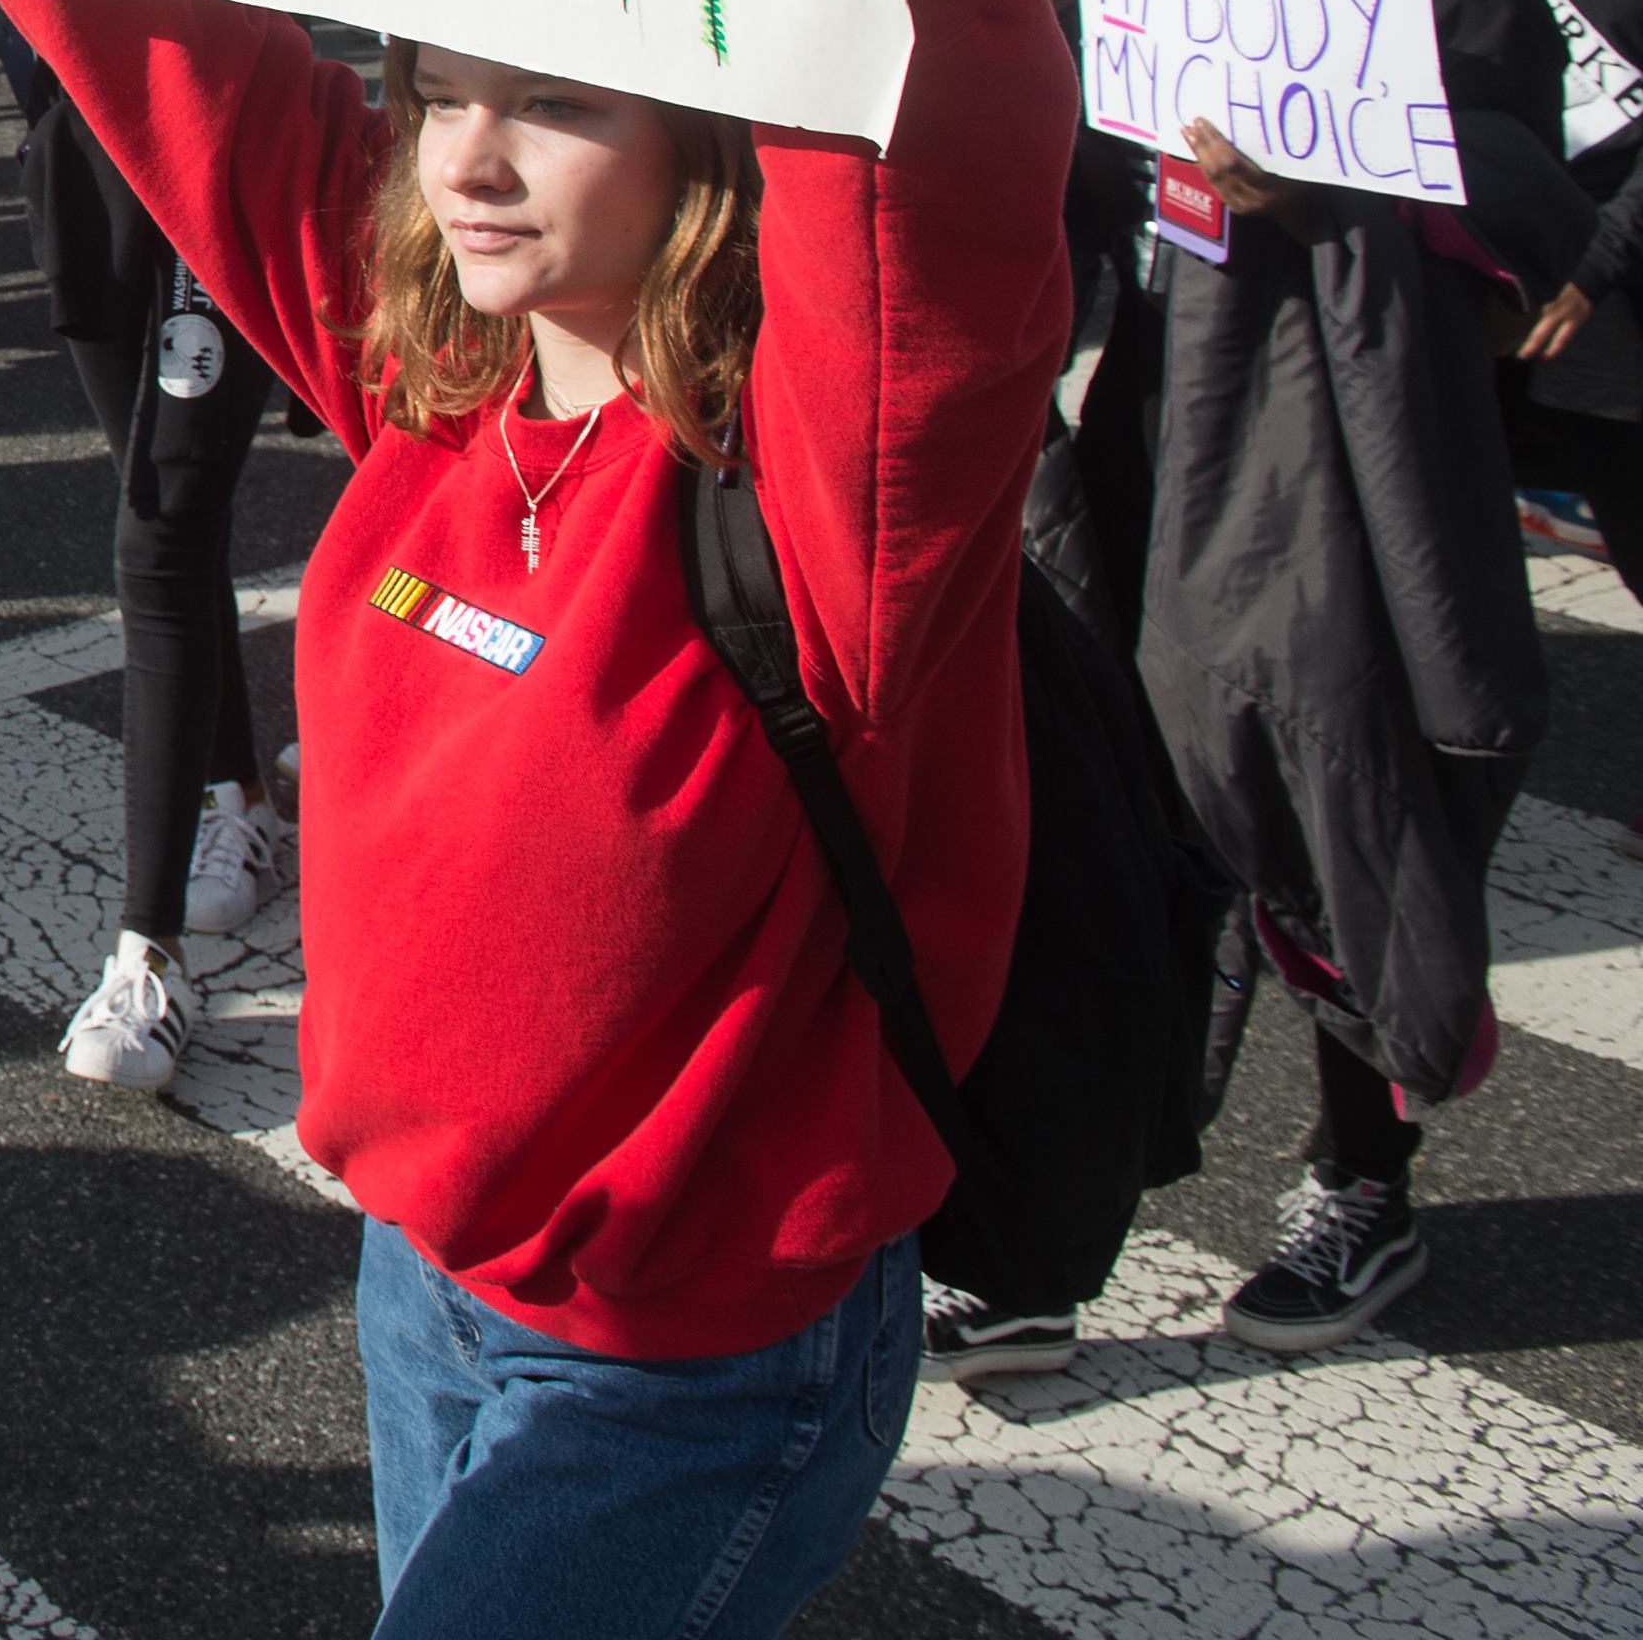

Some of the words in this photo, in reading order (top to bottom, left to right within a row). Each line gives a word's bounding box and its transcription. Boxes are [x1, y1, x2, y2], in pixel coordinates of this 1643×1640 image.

[1096, 33, 1159, 131] MY
[1175, 53, 1456, 191] CHOICE
[423, 595, 532, 670] NASCAR
